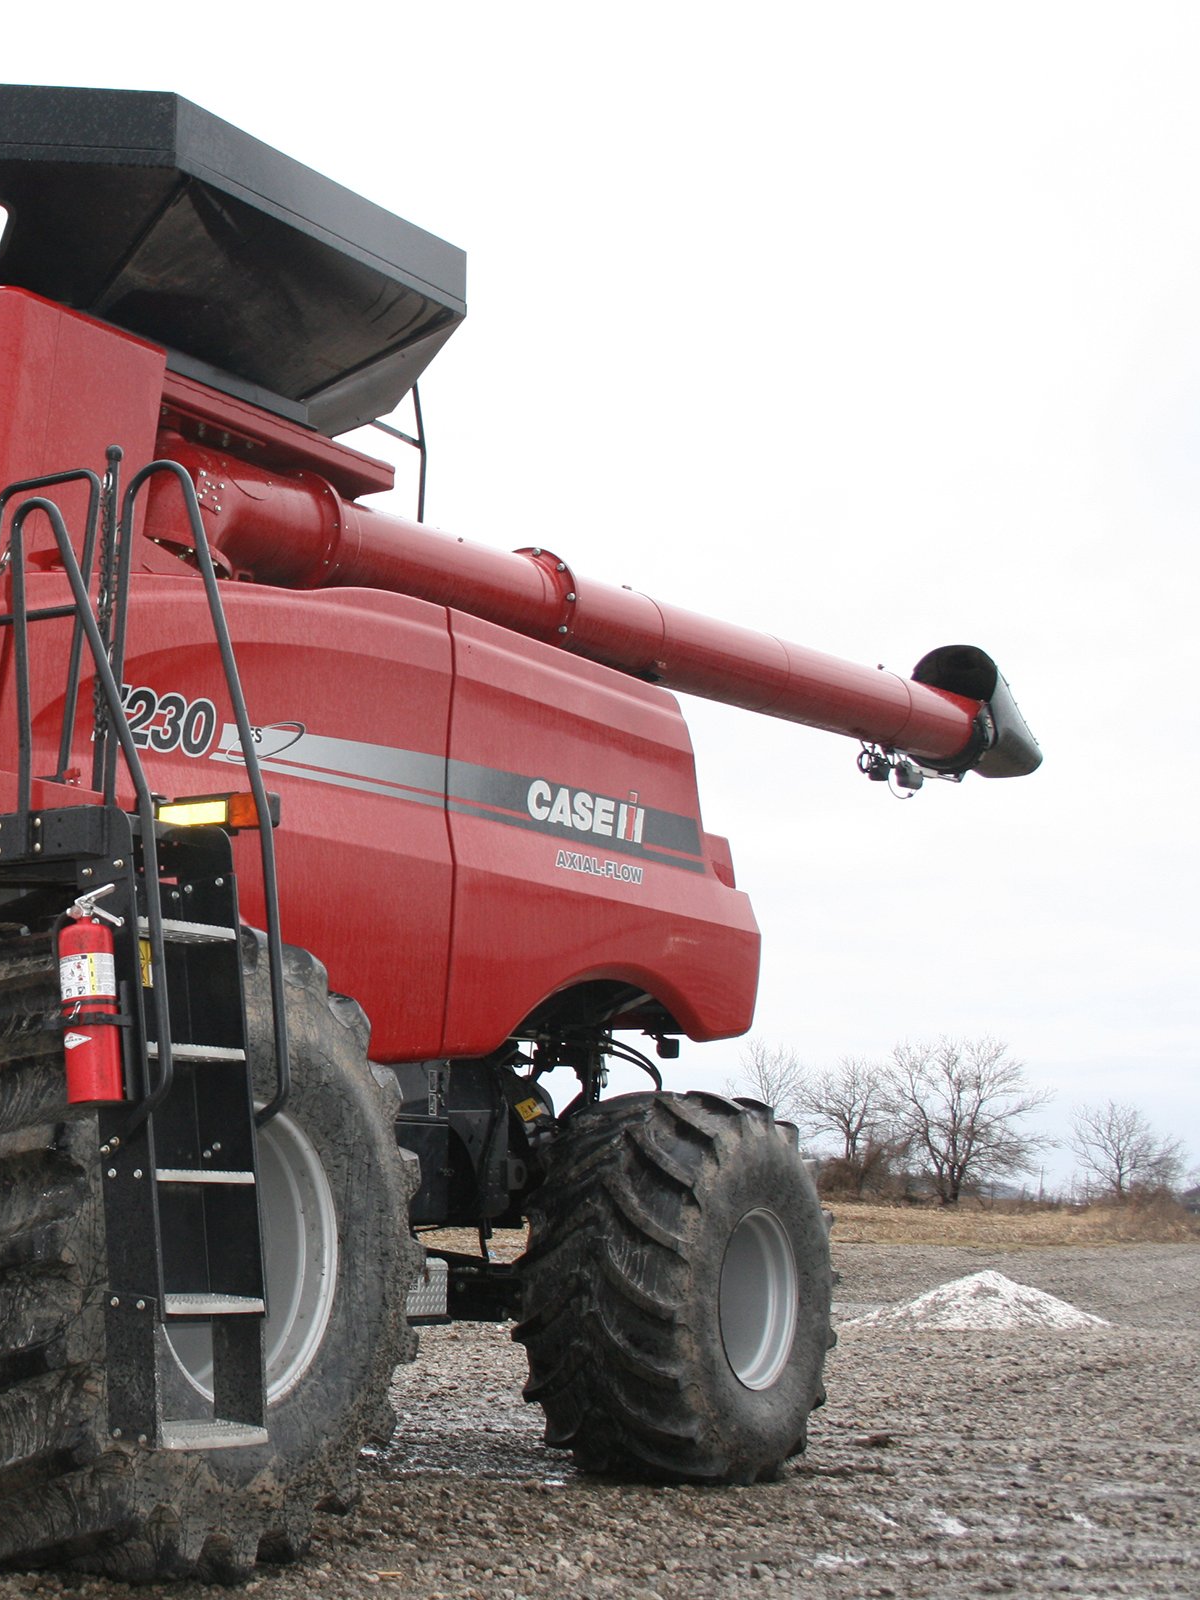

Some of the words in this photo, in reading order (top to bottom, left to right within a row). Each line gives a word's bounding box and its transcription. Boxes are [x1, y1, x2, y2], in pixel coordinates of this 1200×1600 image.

[114, 684, 217, 758] 230
[527, 779, 615, 836] CASE
[555, 849, 643, 885] AXIAL-FLOW
